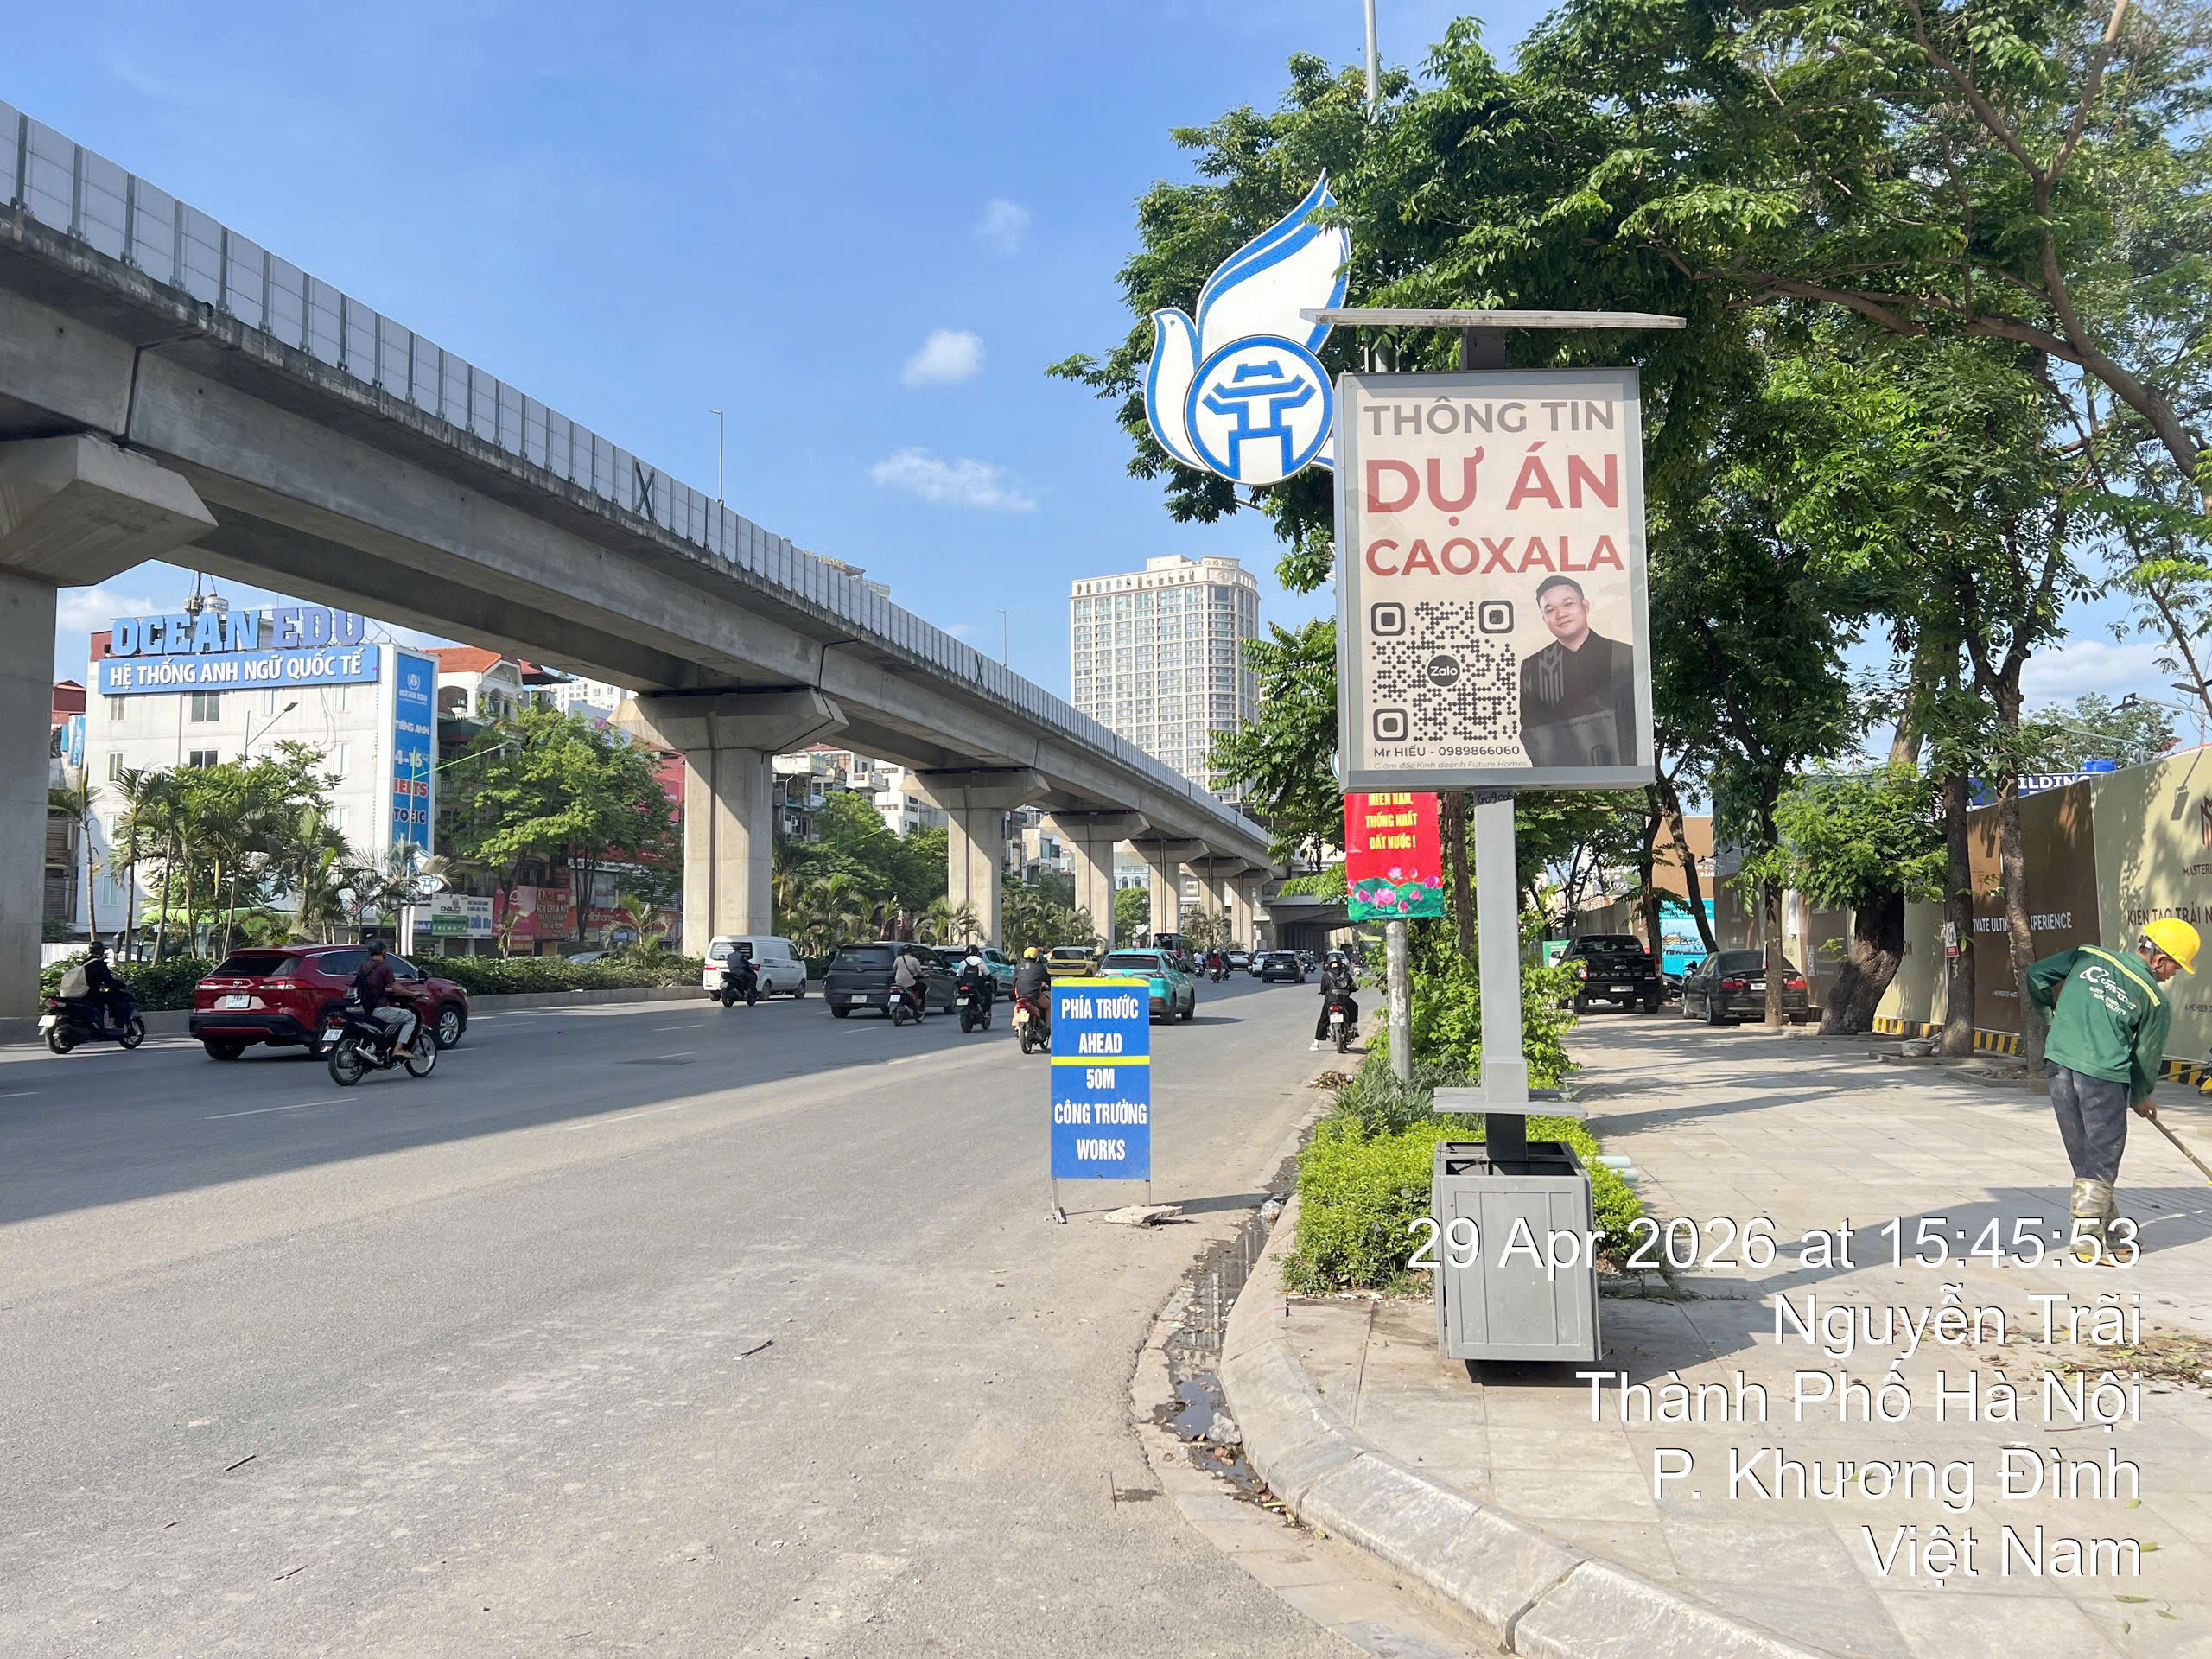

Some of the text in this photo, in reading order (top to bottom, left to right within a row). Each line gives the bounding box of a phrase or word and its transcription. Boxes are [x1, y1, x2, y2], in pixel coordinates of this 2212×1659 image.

[1363, 396, 1614, 435] THÔNG TIN
[1366, 441, 1620, 527] DỰ ÁN
[1365, 534, 1625, 576] CAOXALA
[111, 607, 365, 657] OCEAN EDU
[110, 647, 365, 690] HỆ THỐNG ANH NGỮ QUỐC TẾ
[1430, 665, 1458, 676] Zalo
[415, 724, 429, 735] ANH
[1374, 747, 1390, 757] Mr
[1395, 744, 1426, 757] HIẾU
[1438, 746, 1520, 756] 0989866060
[394, 778, 429, 798] IELTS
[393, 807, 427, 824] TOEIC
[1364, 809, 1417, 829] THỐNG NHẤT
[1387, 832, 1411, 849] NƯỚC
[1061, 993, 1139, 1020] PHÍA TRƯỚC
[1078, 1033, 1122, 1054] AHEAD
[1085, 1068, 1115, 1089] 50M
[1054, 1098, 1147, 1125] CÔNG TRƯỜNG
[1076, 1139, 1126, 1160] WORKS
